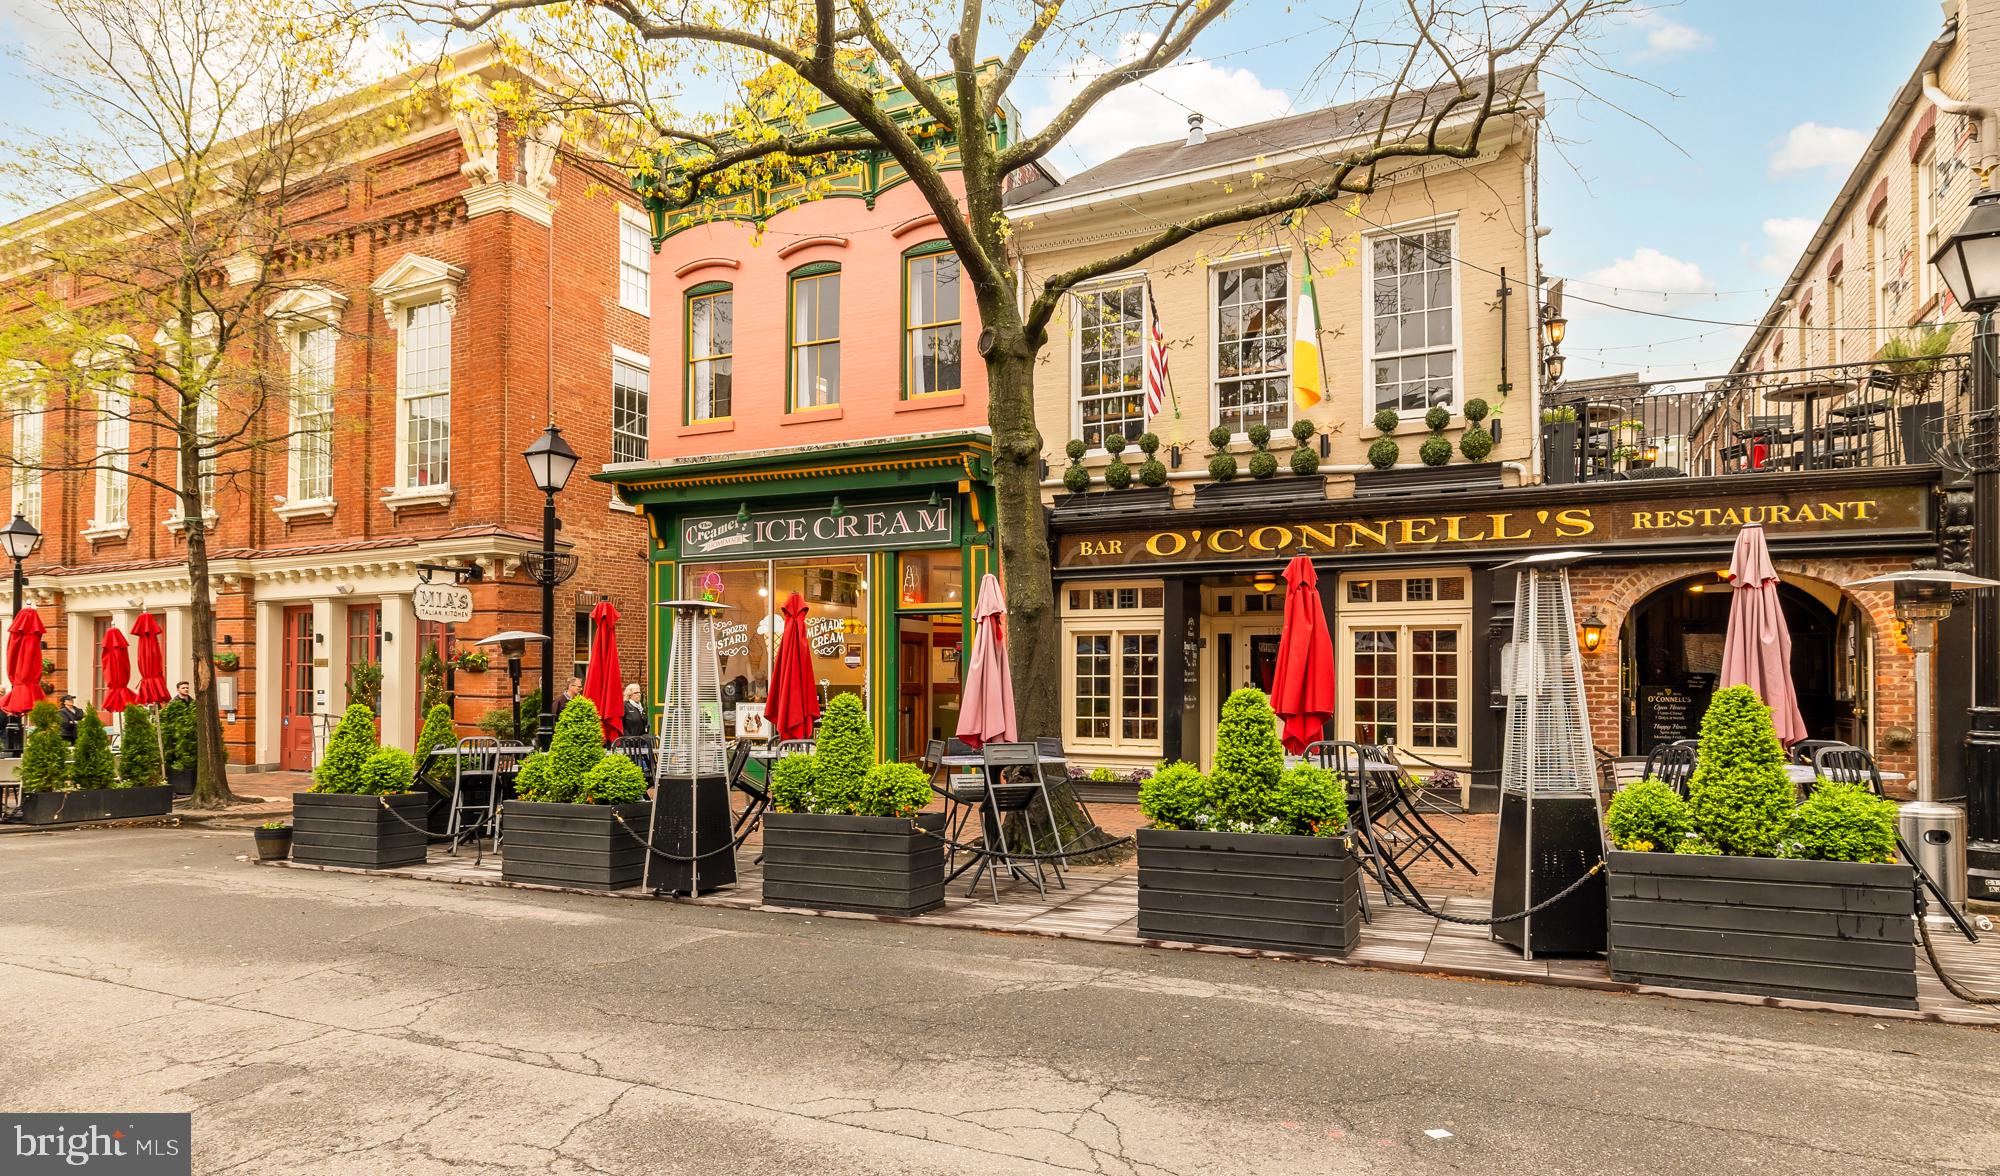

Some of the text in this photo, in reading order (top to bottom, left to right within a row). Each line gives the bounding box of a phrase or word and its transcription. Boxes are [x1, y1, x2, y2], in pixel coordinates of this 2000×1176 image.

[754, 508, 948, 542] ICE CREAM
[1079, 500, 1876, 556] BAR O'CONNELL'S RESTAURANT
[419, 590, 469, 610] MIA'S
[722, 624, 748, 637] FROZEN
[807, 618, 845, 639] MEMADE
[811, 631, 845, 649] CREAM
[1648, 695, 1691, 703] O'CONNELL'S
